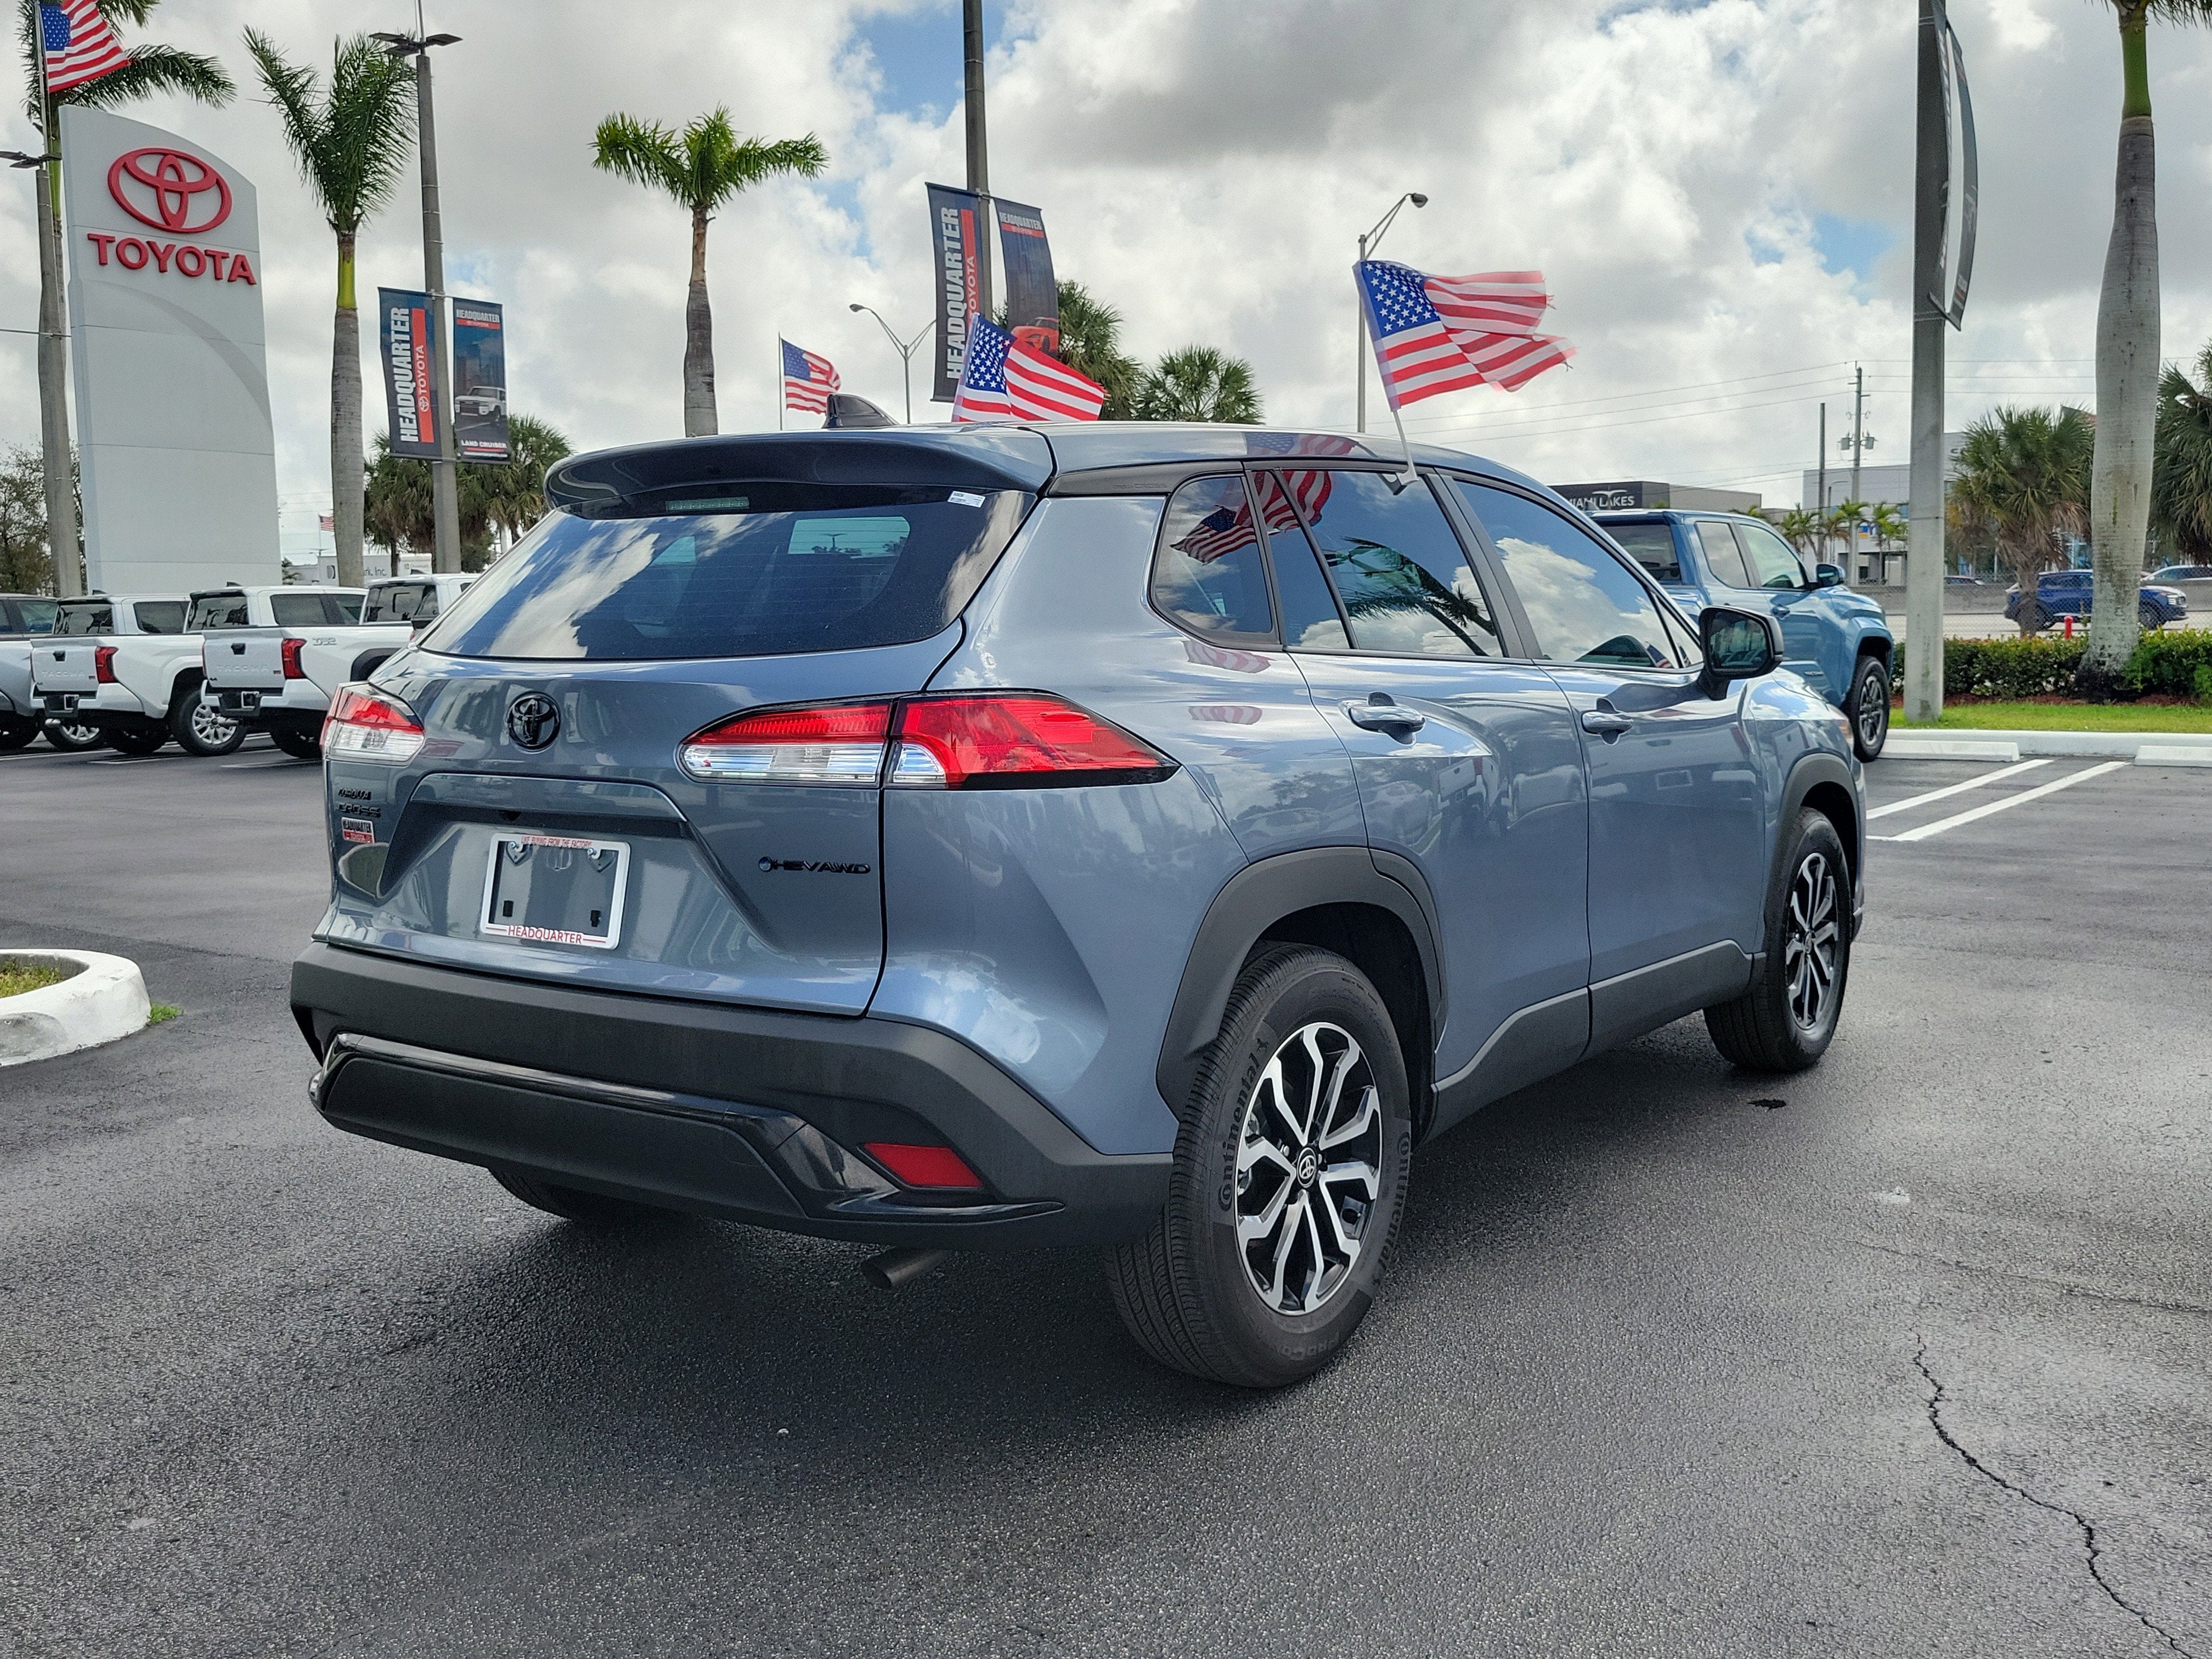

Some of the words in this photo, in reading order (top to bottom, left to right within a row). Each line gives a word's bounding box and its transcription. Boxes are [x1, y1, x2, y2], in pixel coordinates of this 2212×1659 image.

[87, 233, 257, 286] TOYOTA
[456, 309, 500, 323] HEADQUARTER
[941, 207, 967, 379] HEADQUARTER
[390, 307, 419, 442] HEADQUARTER
[416, 346, 427, 396] TOYOTA
[1599, 496, 1635, 507] LAKES
[507, 925, 583, 944] HEADQUARTER
[1218, 1052, 1261, 1211] Continental
